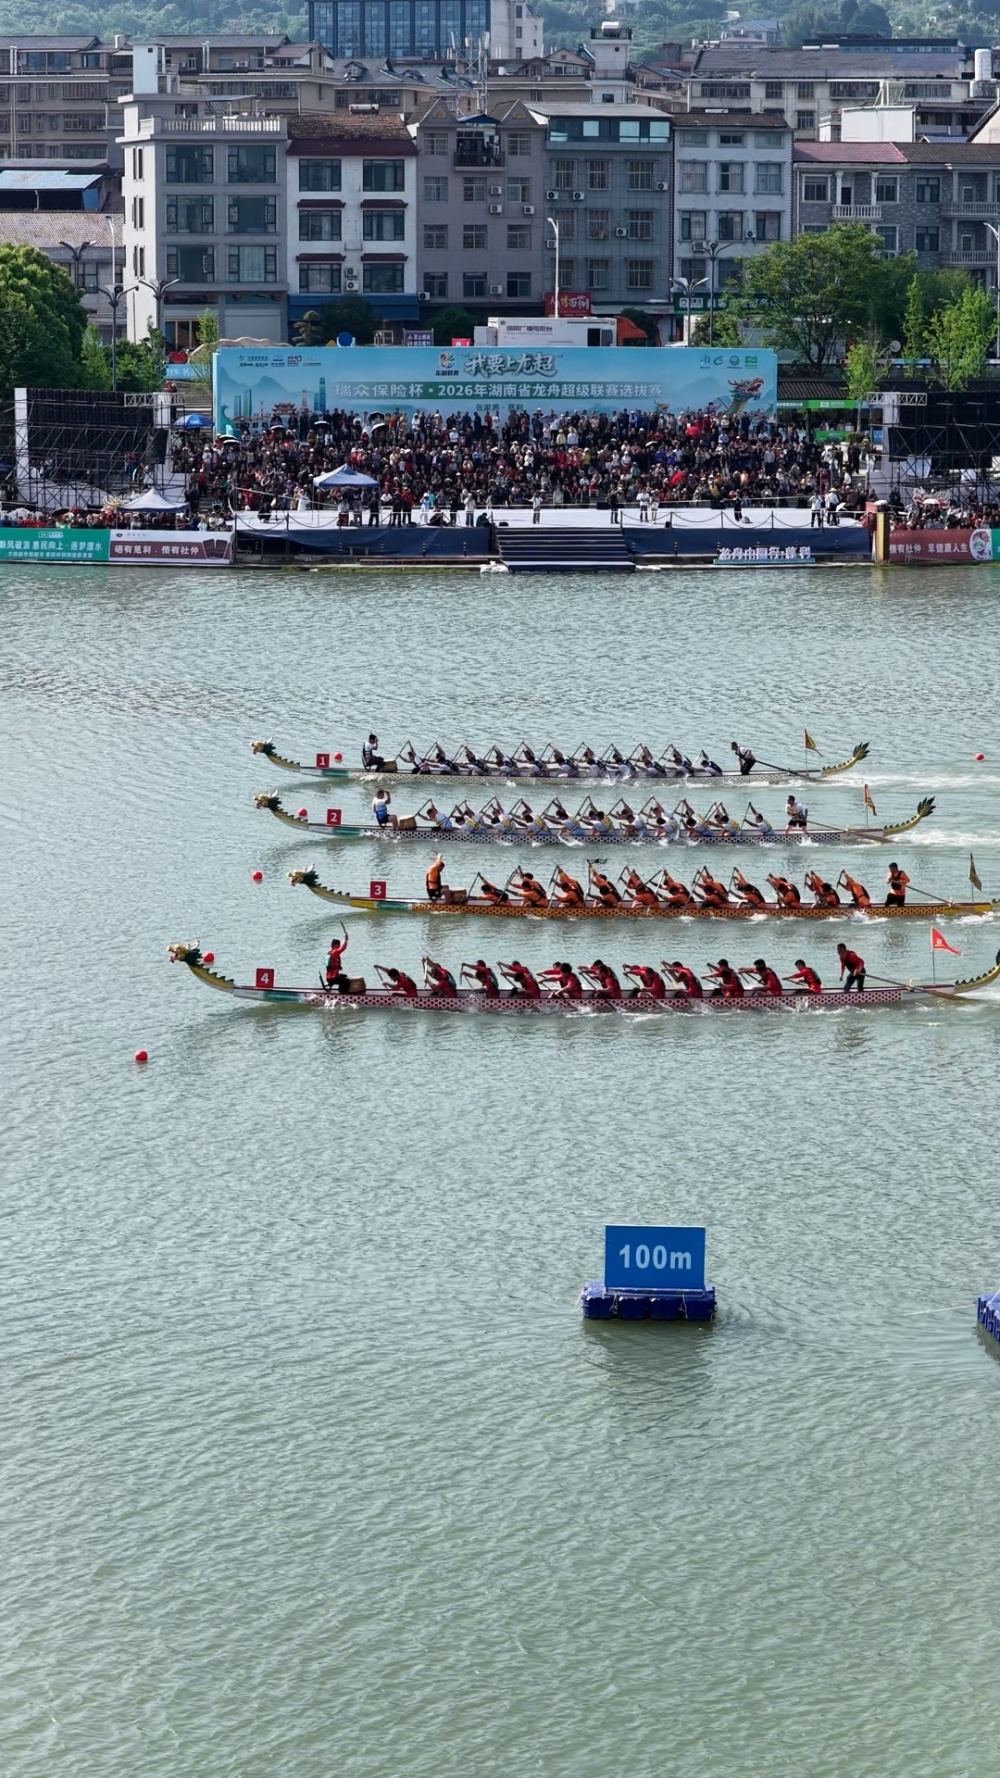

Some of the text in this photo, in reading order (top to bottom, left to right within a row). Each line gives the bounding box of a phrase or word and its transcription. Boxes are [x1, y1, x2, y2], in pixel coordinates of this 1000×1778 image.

[320, 756, 326, 765] 1
[330, 812, 338, 822] 2
[374, 885, 382, 895] 3
[260, 972, 270, 984] 4
[619, 1244, 692, 1270] 100m
